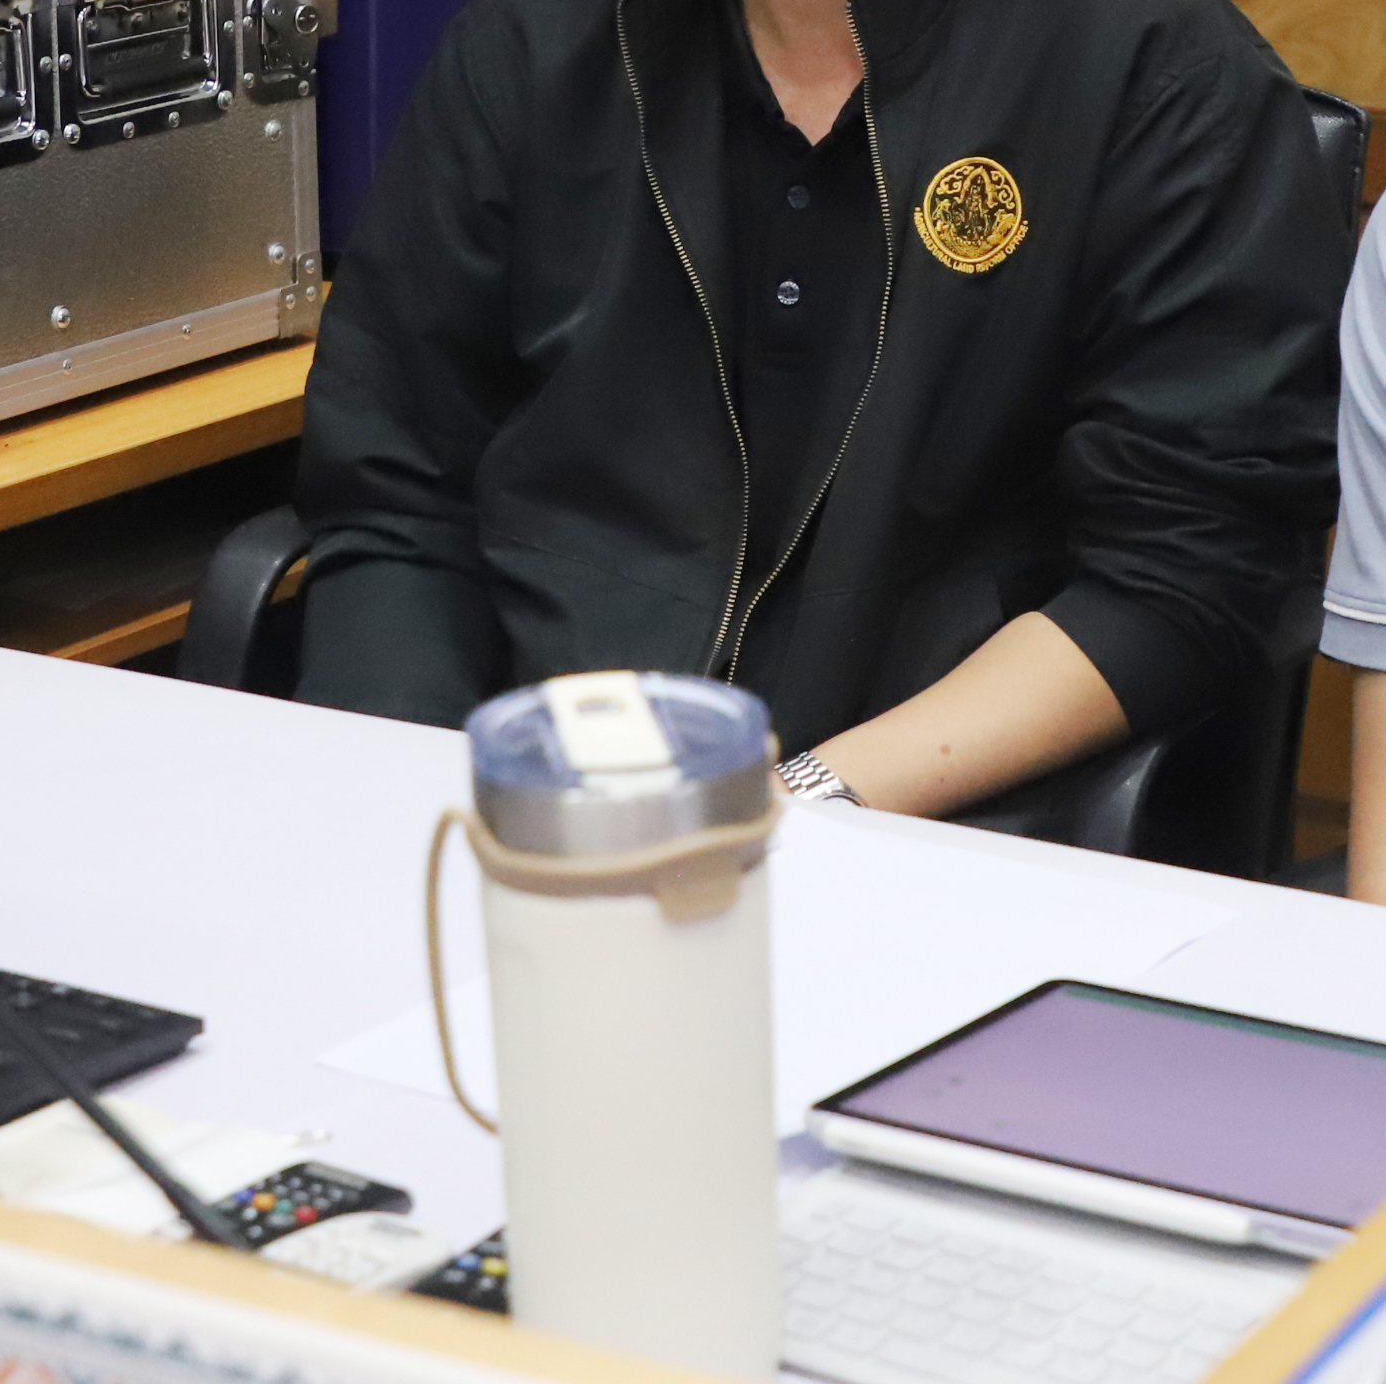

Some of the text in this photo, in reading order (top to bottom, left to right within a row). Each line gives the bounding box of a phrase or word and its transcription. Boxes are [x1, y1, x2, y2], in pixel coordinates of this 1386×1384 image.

[914, 212, 1029, 274] AGRICULTURAL LAND REFORM OFFICE
